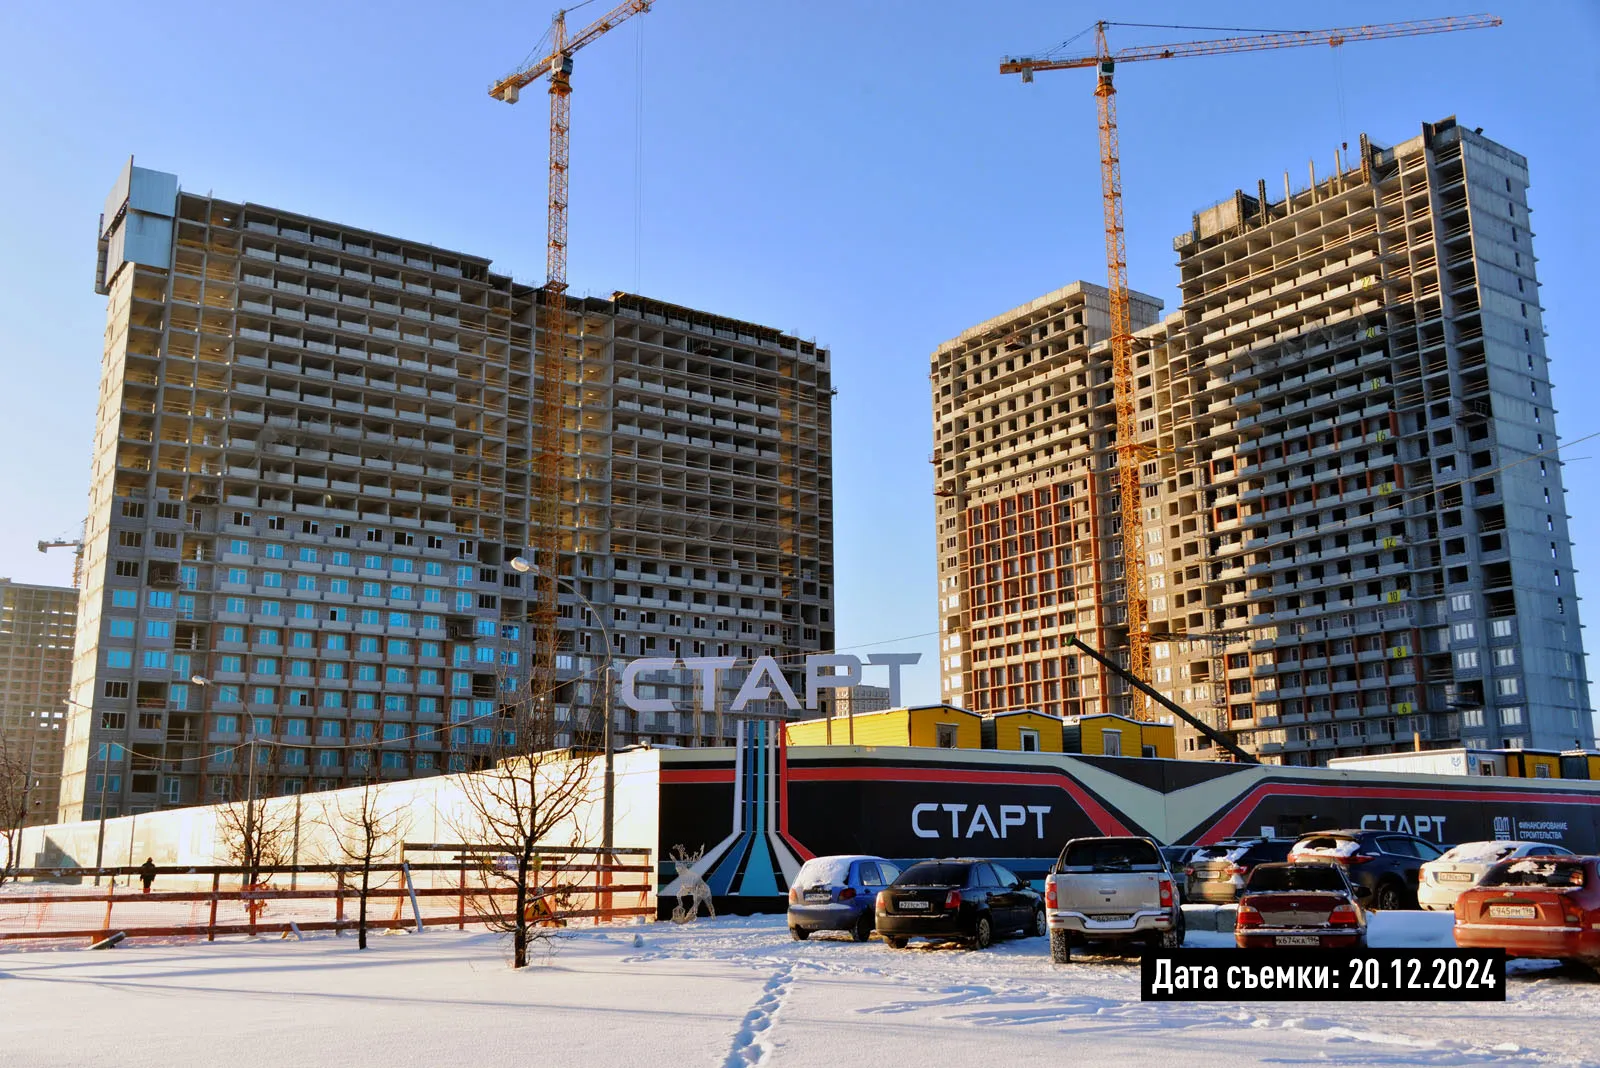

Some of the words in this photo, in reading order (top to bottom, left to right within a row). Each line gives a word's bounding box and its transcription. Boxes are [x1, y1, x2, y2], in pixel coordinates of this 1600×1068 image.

[621, 652, 922, 712] СТАРТ
[911, 803, 1052, 839] СТАРТ
[1518, 821, 1568, 830] ФИНАНСИРОВАНИЕ
[1519, 830, 1563, 840] СТРОИТЕЛЬСТВА
